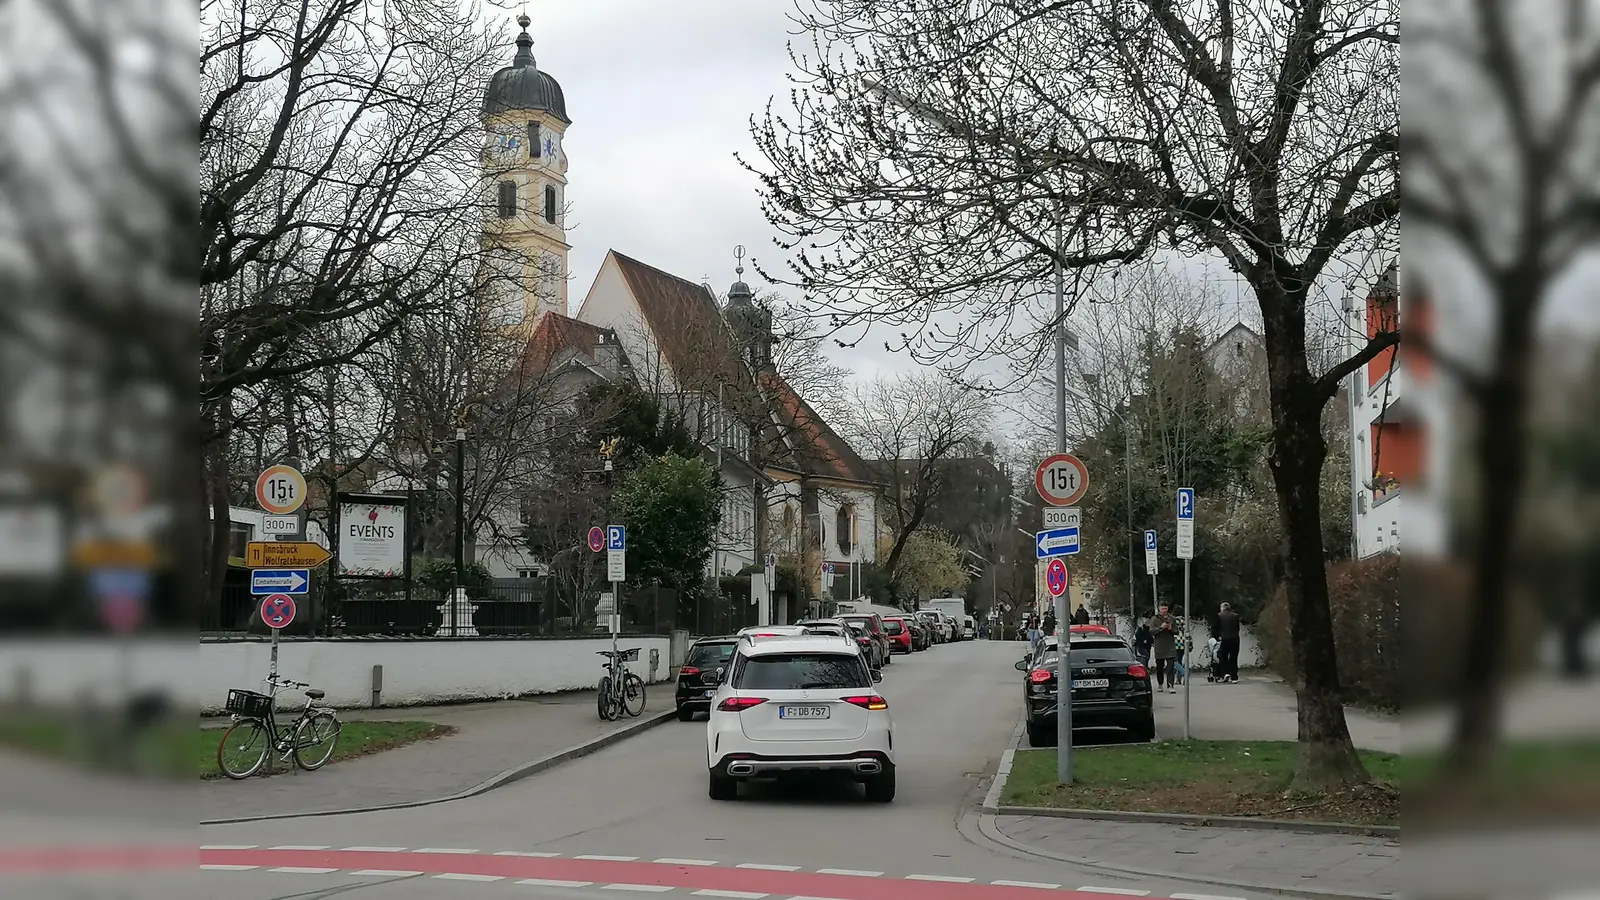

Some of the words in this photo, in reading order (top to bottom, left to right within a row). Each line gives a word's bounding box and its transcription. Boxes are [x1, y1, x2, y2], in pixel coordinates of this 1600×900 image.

[1180, 491, 1190, 515] P
[350, 524, 395, 539] EVENTS
[610, 528, 620, 548] P
[1146, 532, 1154, 548] P
[253, 548, 260, 560] 11
[265, 544, 299, 554] Innsbruck
[265, 556, 317, 566] Wolfratshausen
[810, 707, 826, 716] 757
